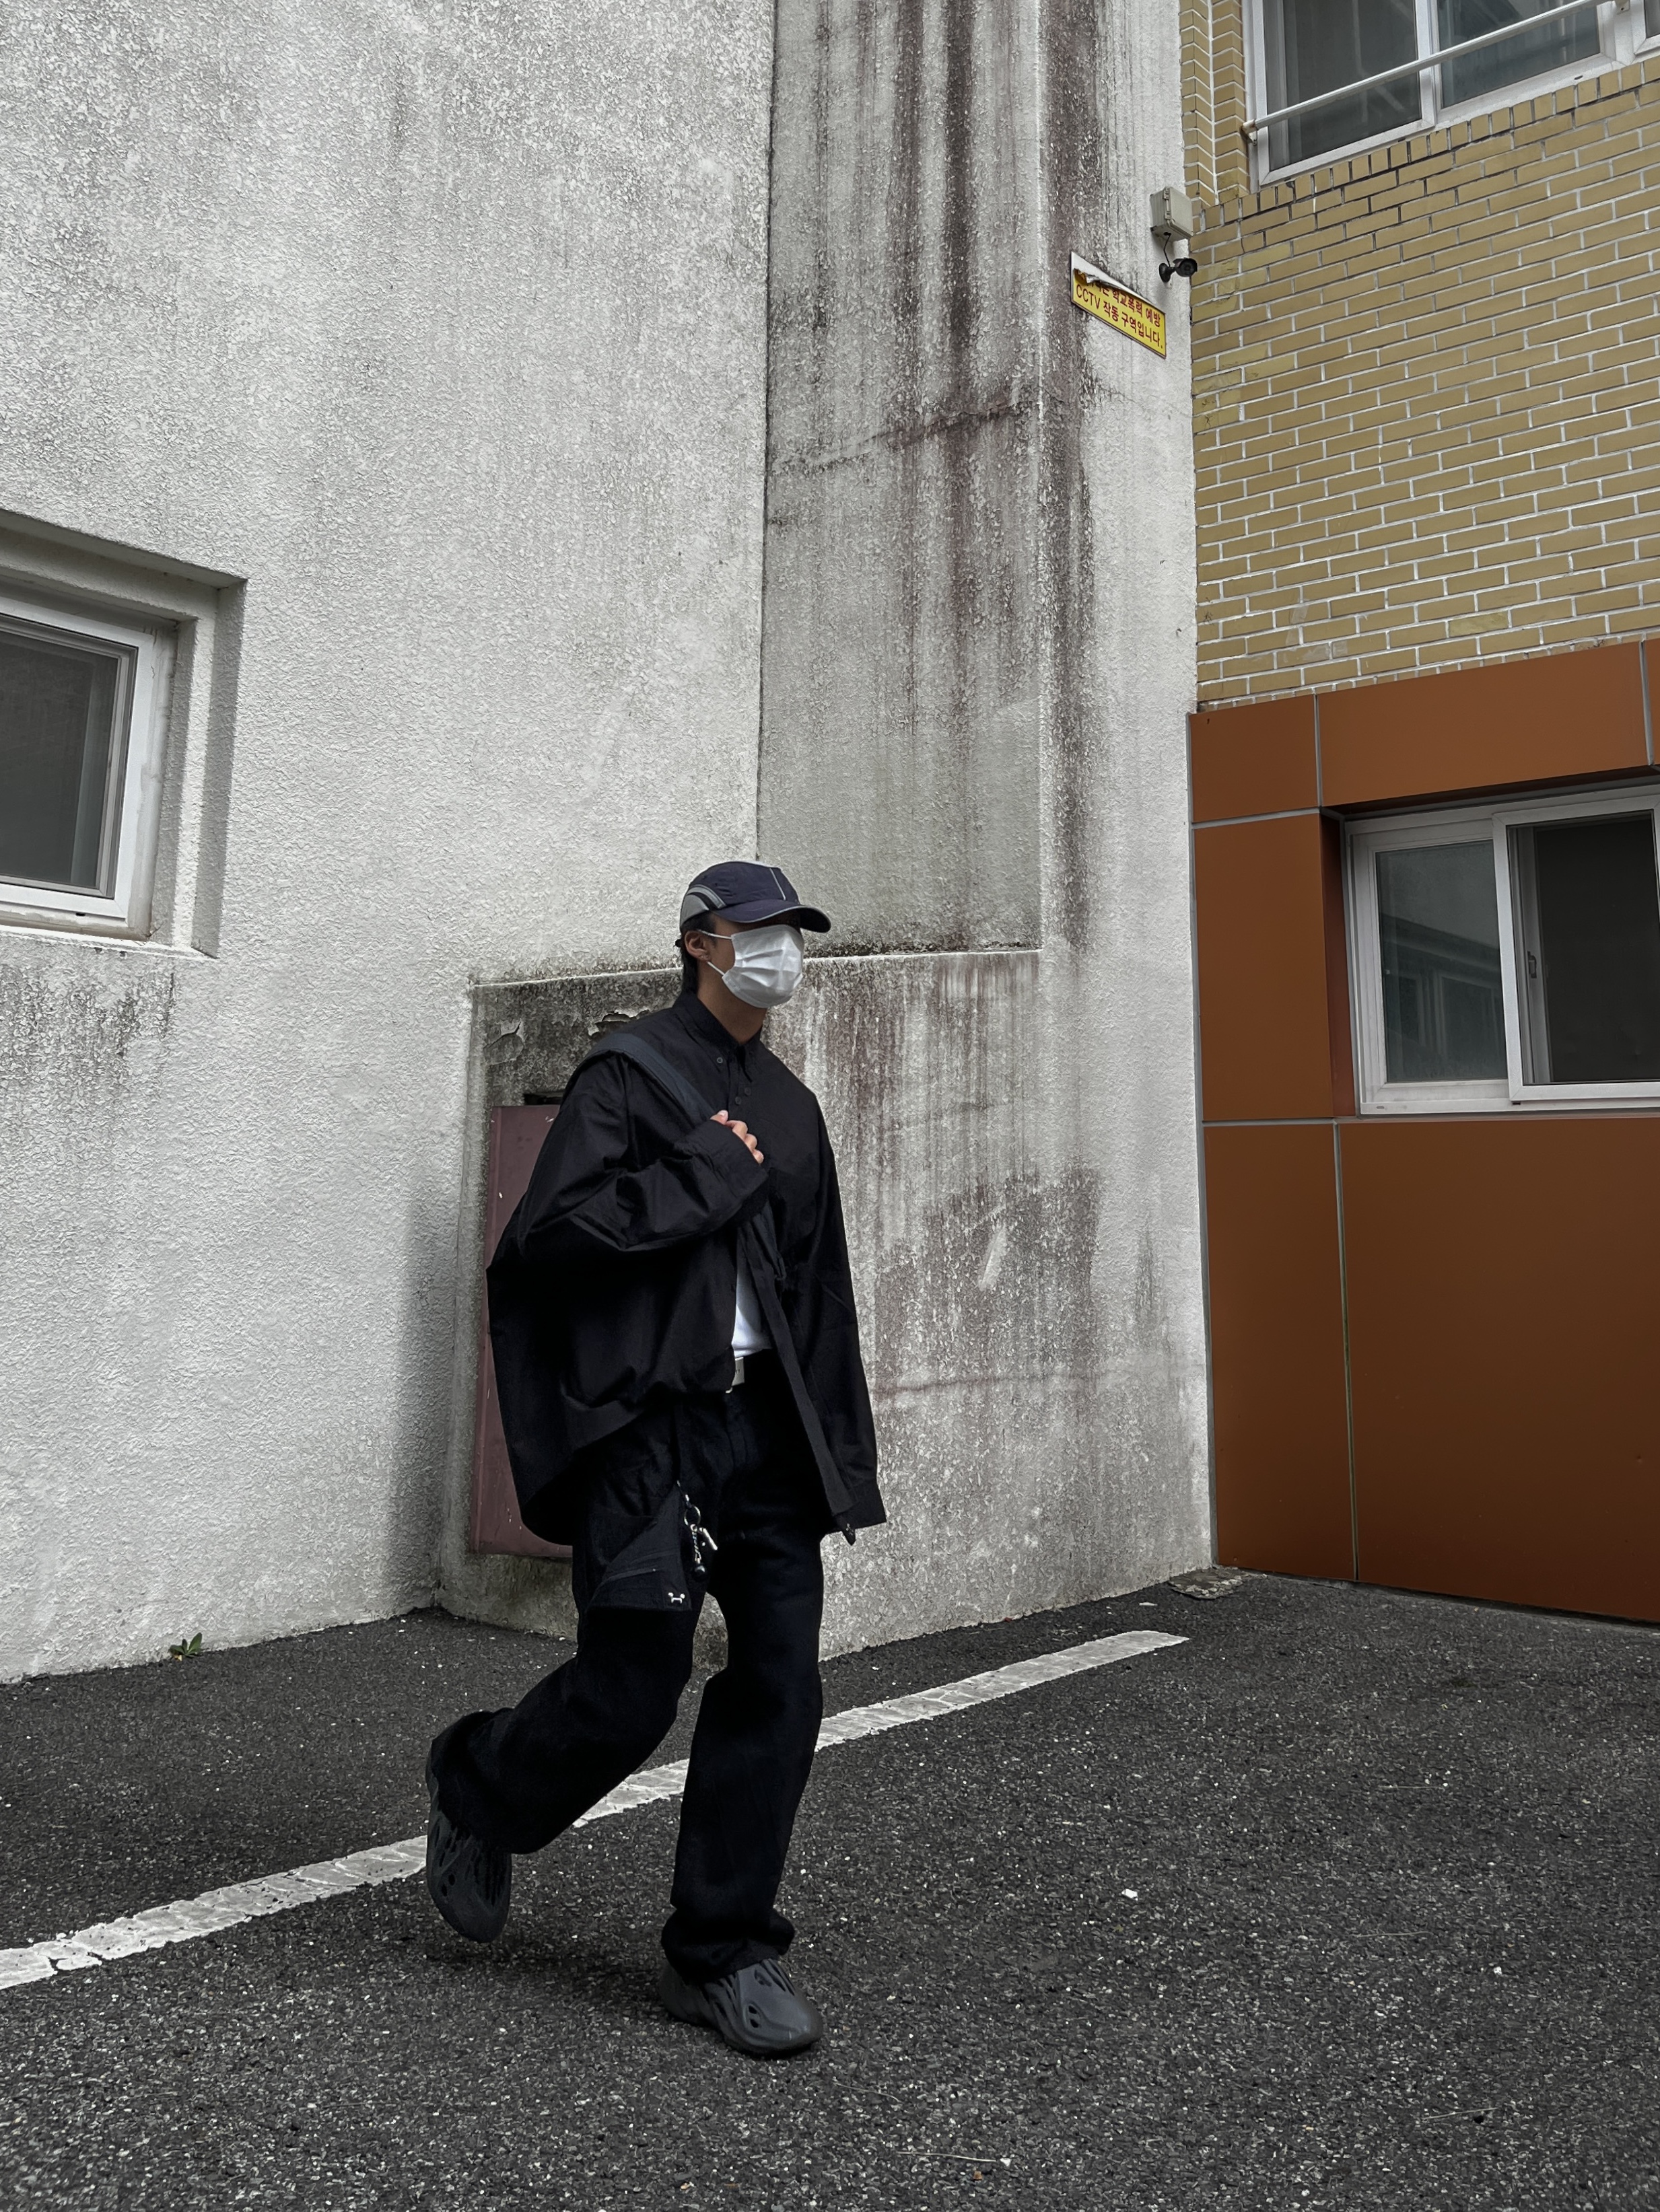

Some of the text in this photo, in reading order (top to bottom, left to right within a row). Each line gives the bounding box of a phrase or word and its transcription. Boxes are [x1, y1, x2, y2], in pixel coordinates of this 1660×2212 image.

[1076, 283, 1101, 310] CCTV
[1103, 300, 1119, 322] 작동
[1121, 311, 1163, 349] 구역입니다.
[1146, 308, 1161, 328] 예방
